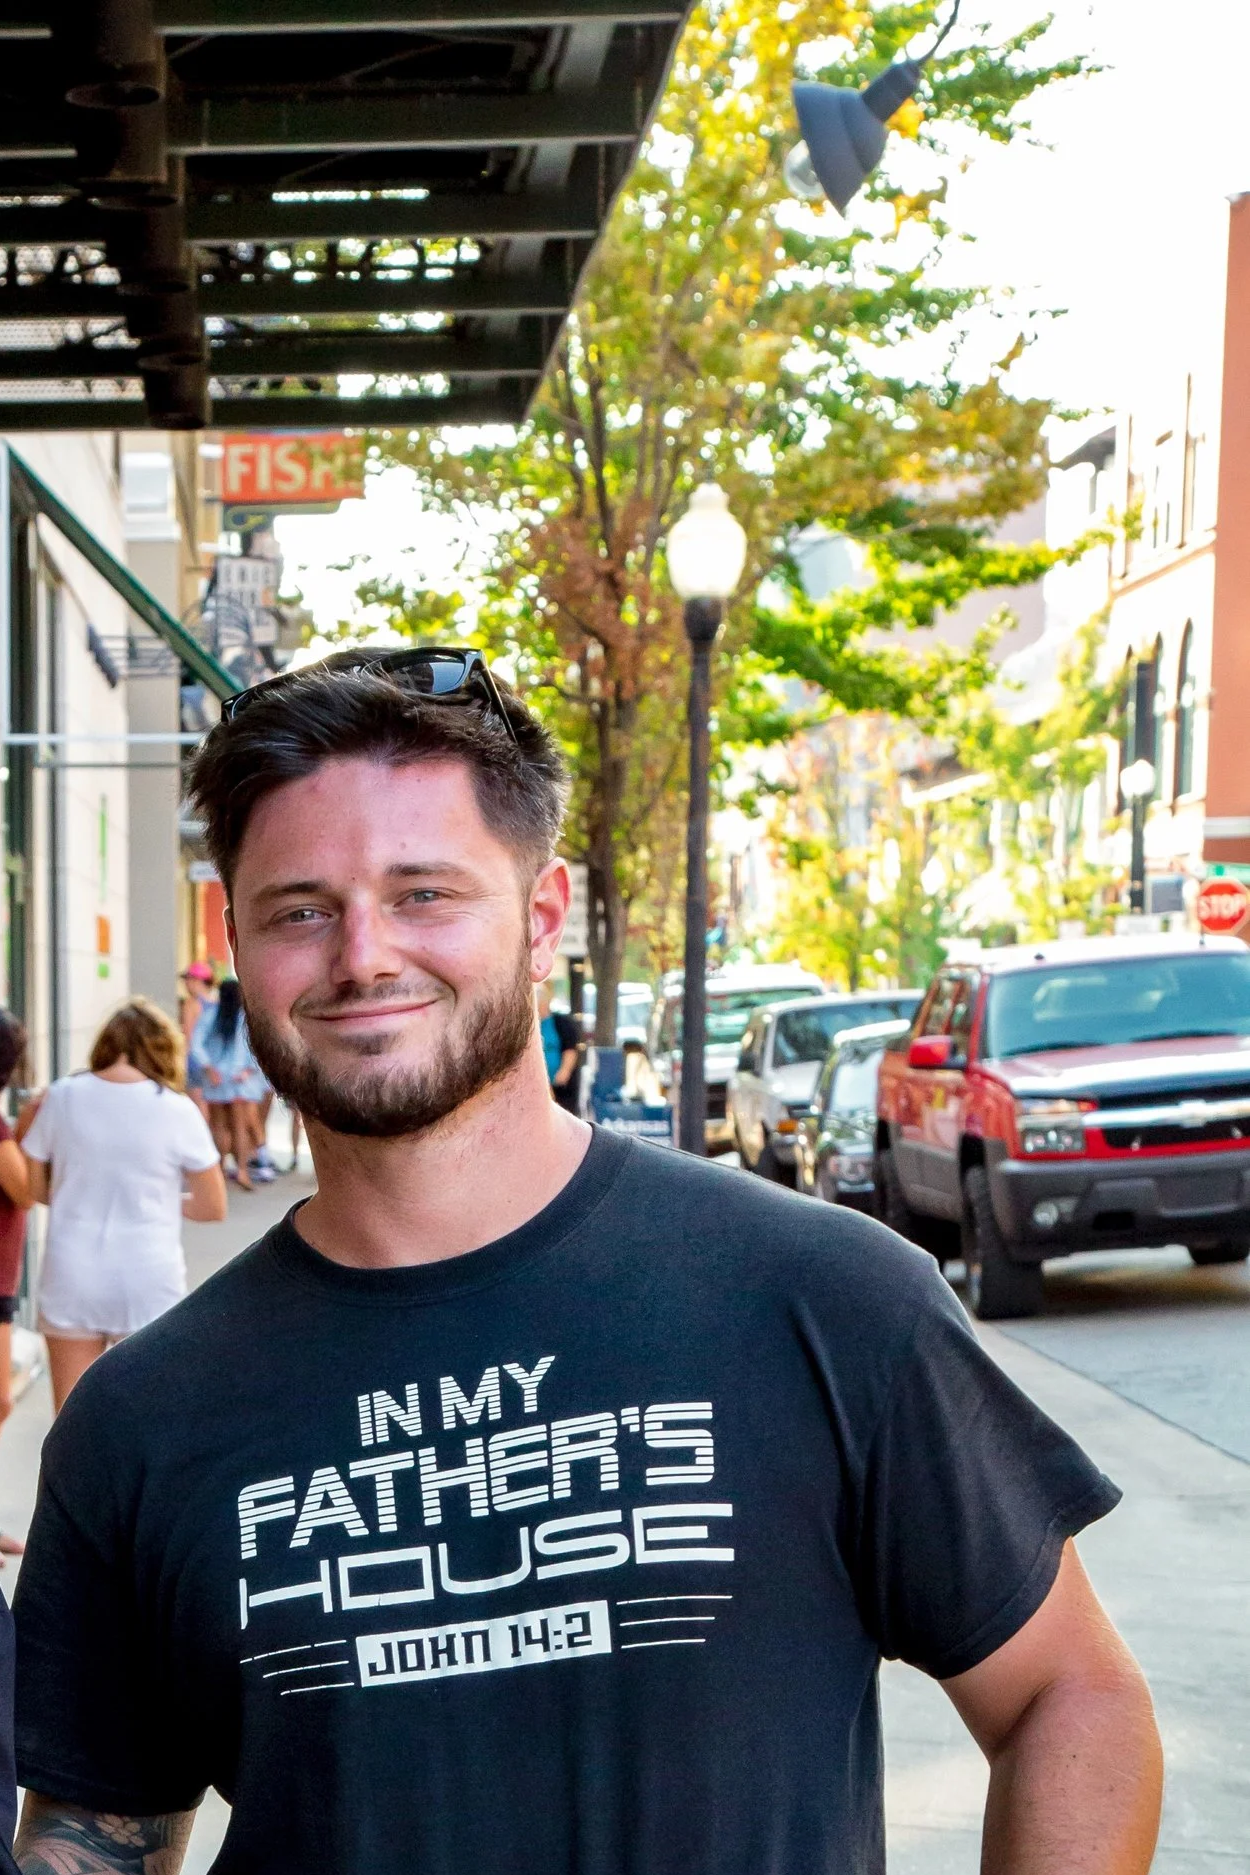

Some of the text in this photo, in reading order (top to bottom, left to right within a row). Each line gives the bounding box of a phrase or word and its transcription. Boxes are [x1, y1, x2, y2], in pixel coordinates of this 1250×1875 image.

[1196, 891, 1247, 919] STOP
[357, 1355, 556, 1446] IN MY
[238, 1402, 714, 1559] FATHER'S
[239, 1503, 735, 1629] HOUSE
[367, 1611, 593, 1678] JOHN 14:2
